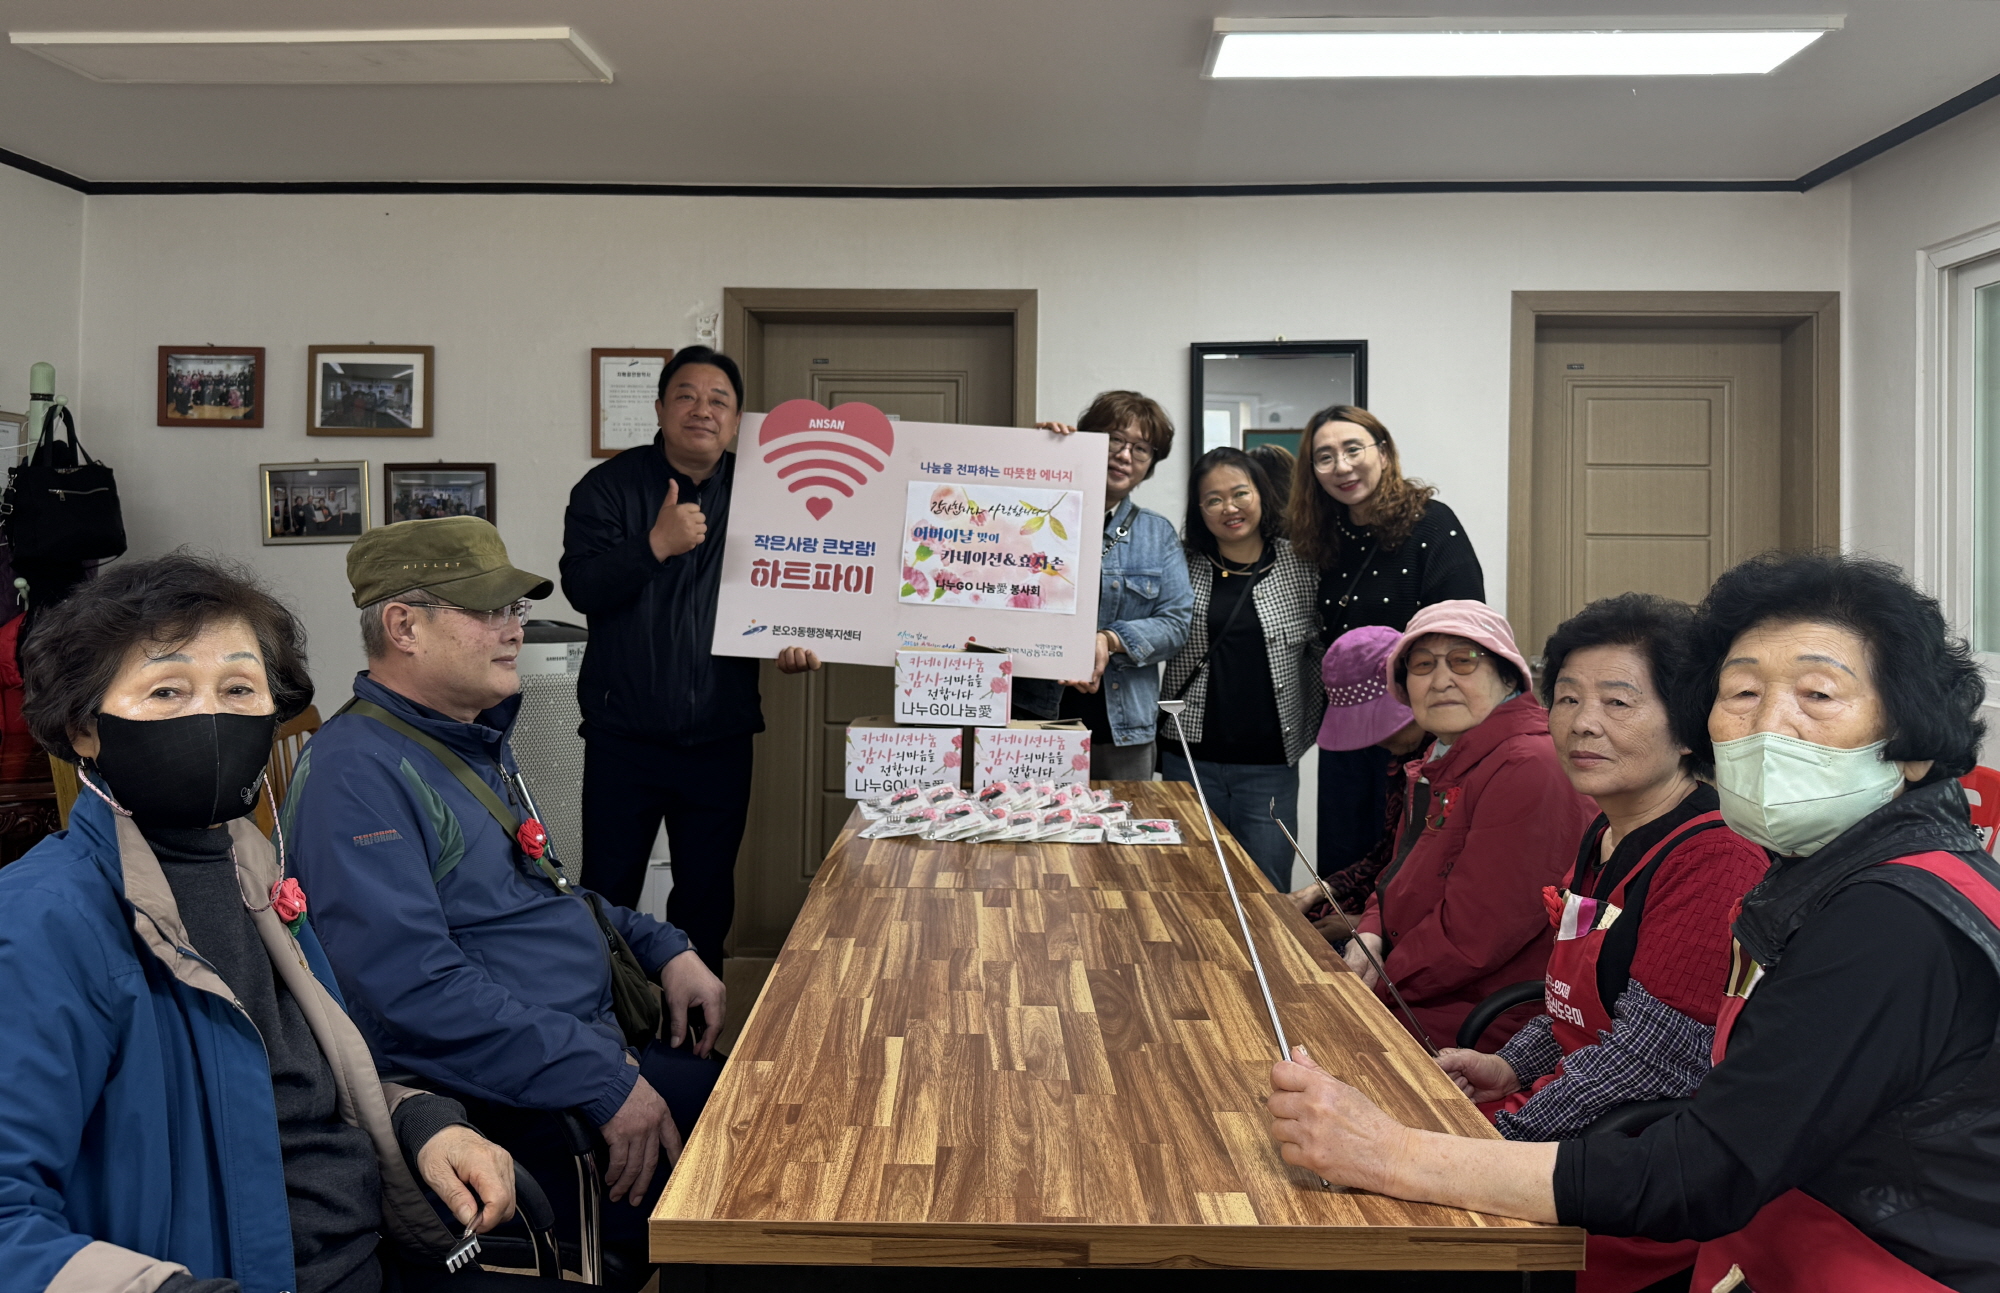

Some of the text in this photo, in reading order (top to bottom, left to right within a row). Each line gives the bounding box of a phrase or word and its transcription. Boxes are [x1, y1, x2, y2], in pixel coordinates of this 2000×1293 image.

[809, 419, 845, 431] ANSAN
[920, 462, 1073, 482] 나눔을 전파하는 따뜻한 에너지
[930, 499, 1049, 521] 감사합니다 사랑합니다
[913, 526, 1000, 544] 어버이날 맞이
[754, 534, 876, 557] 작은사랑 큰보람!
[403, 562, 460, 570] MILLET
[941, 549, 1065, 572] 카네이션&효자손
[750, 558, 874, 595] 하트파이
[935, 578, 973, 591] 나누GO
[1009, 584, 1041, 597] 봉사회
[771, 625, 862, 641] 본오3동행정복지센터
[927, 686, 974, 701] 전합니다
[902, 701, 992, 719] 나누GO나눔愛
[880, 761, 927, 777] 전합니다
[1008, 763, 1055, 778] 전합니다
